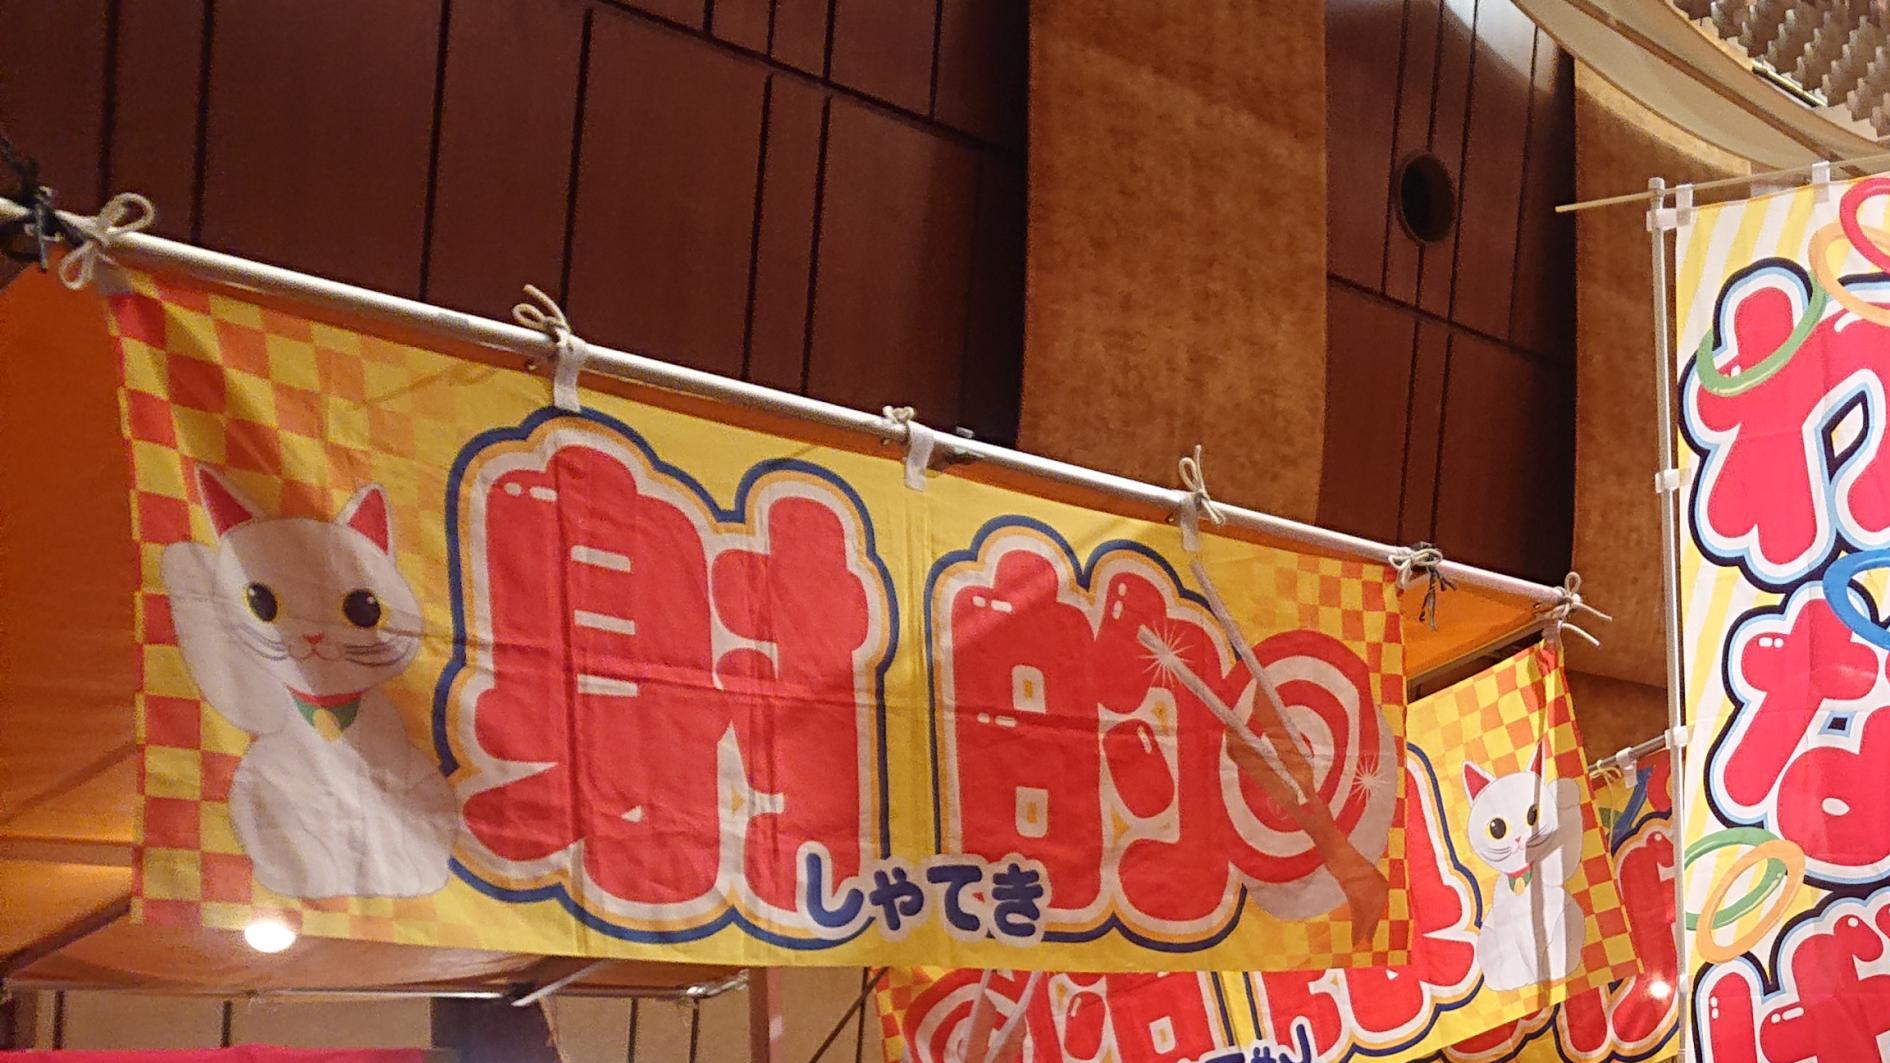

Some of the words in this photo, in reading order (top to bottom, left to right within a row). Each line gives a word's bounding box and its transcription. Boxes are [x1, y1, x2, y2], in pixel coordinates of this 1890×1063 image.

[458, 438, 1240, 924] 射的
[805, 852, 1045, 938] しゃてき
